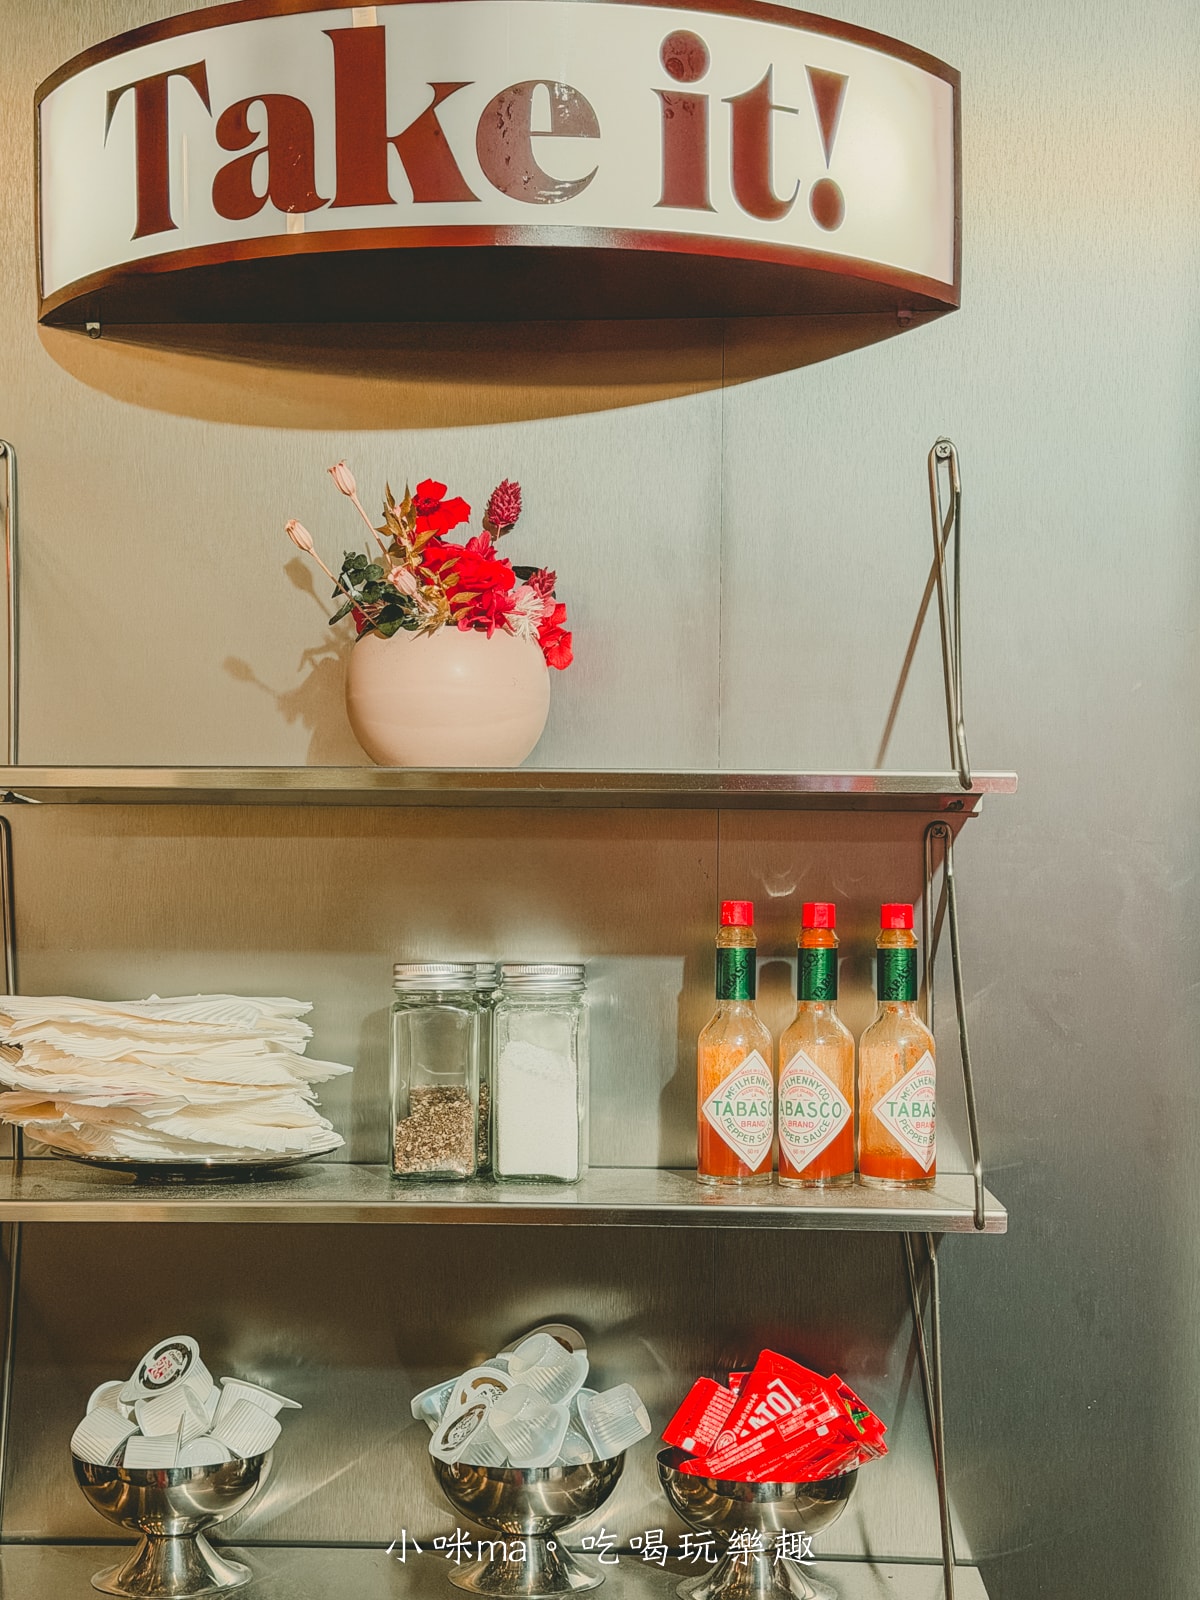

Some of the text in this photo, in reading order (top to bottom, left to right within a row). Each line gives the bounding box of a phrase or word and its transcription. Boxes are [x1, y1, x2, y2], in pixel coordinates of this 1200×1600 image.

[104, 26, 849, 240] Take it!
[712, 1100, 772, 1117] TABASC
[779, 1100, 842, 1118] ABASCO
[886, 1101, 936, 1117] TABAS
[724, 1117, 755, 1143] PEPPER
[788, 1120, 814, 1128] BRAND
[803, 1120, 830, 1144] SAUCE
[899, 1118, 928, 1144] PEPPER
